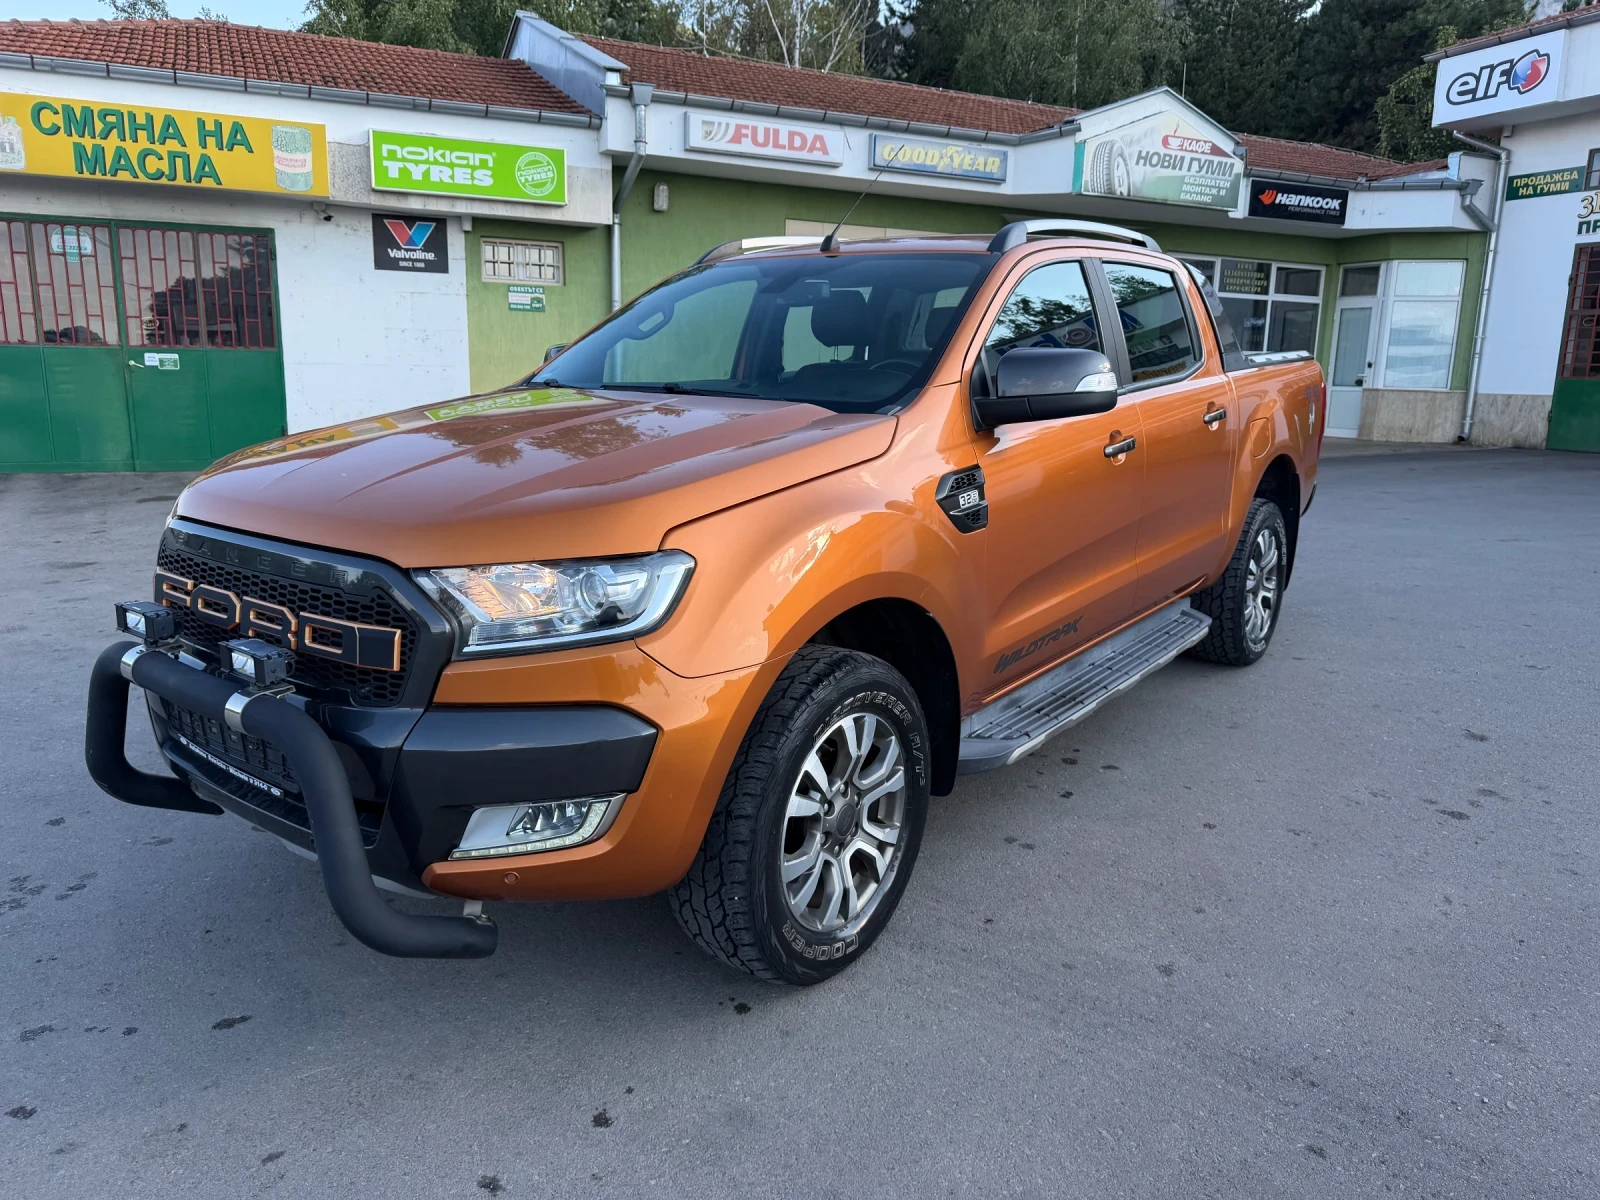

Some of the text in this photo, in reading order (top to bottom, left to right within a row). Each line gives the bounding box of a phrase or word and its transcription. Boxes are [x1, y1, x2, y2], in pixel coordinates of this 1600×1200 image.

[1446, 58, 1515, 105] elf
[30, 101, 254, 153] СМЯНА НА
[726, 123, 830, 156] FULDA
[1182, 139, 1213, 154] КАФЕ
[73, 141, 222, 185] МАСЛА
[1135, 150, 1235, 178] НОВИ ГУМИ
[382, 161, 493, 186] TYRES
[519, 171, 554, 182] TYRES
[1184, 175, 1231, 188] БЕЗПЛАТЕН
[1513, 170, 1578, 188] ПРОДАЖБА
[1180, 192, 1212, 203] БАЛАНС
[1182, 184, 1227, 196] МОНТАЖ И
[1519, 182, 1570, 196] НА ГУМИ
[1287, 206, 1325, 215] PERFORMANCE
[387, 248, 435, 260] Valvoline
[993, 615, 1084, 674] WILDTRAK
[782, 919, 859, 961] COOPER
